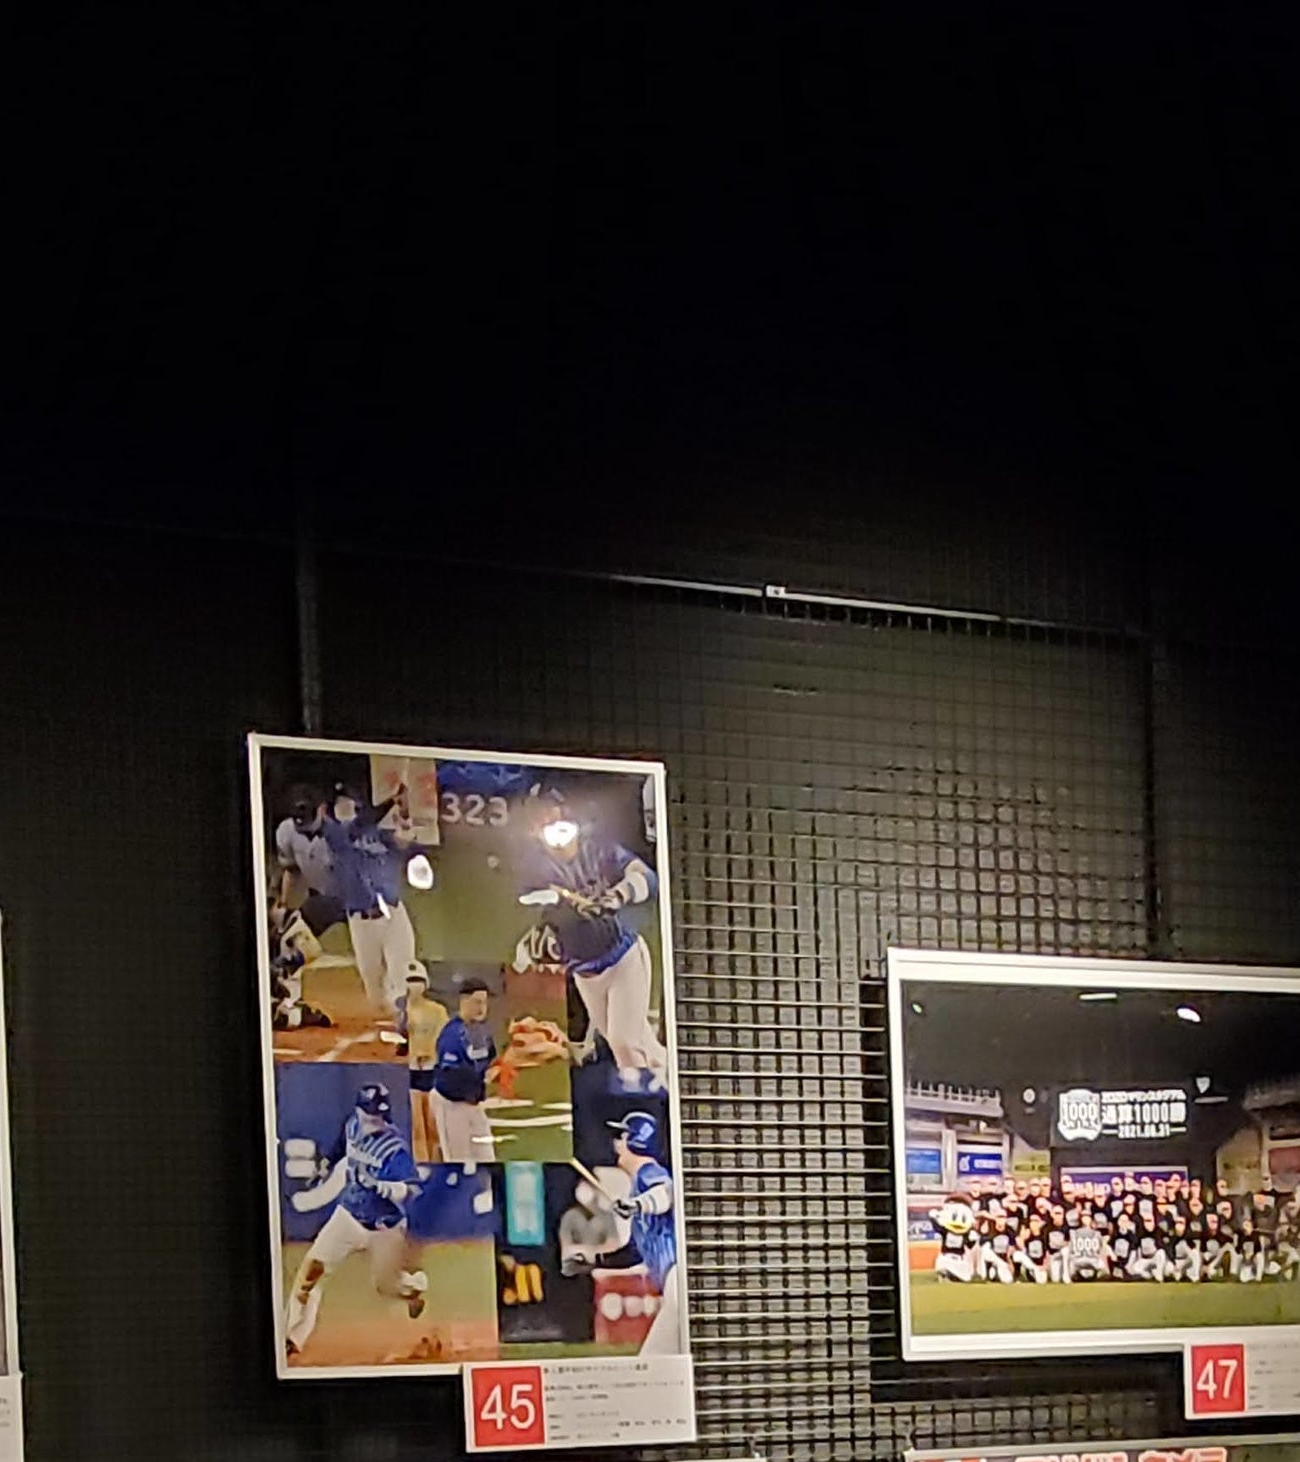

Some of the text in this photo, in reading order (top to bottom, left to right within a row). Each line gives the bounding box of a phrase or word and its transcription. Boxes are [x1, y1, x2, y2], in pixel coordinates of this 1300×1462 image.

[441, 793, 508, 827] 323
[1196, 1359, 1238, 1400] 47
[480, 1383, 536, 1431] 45
